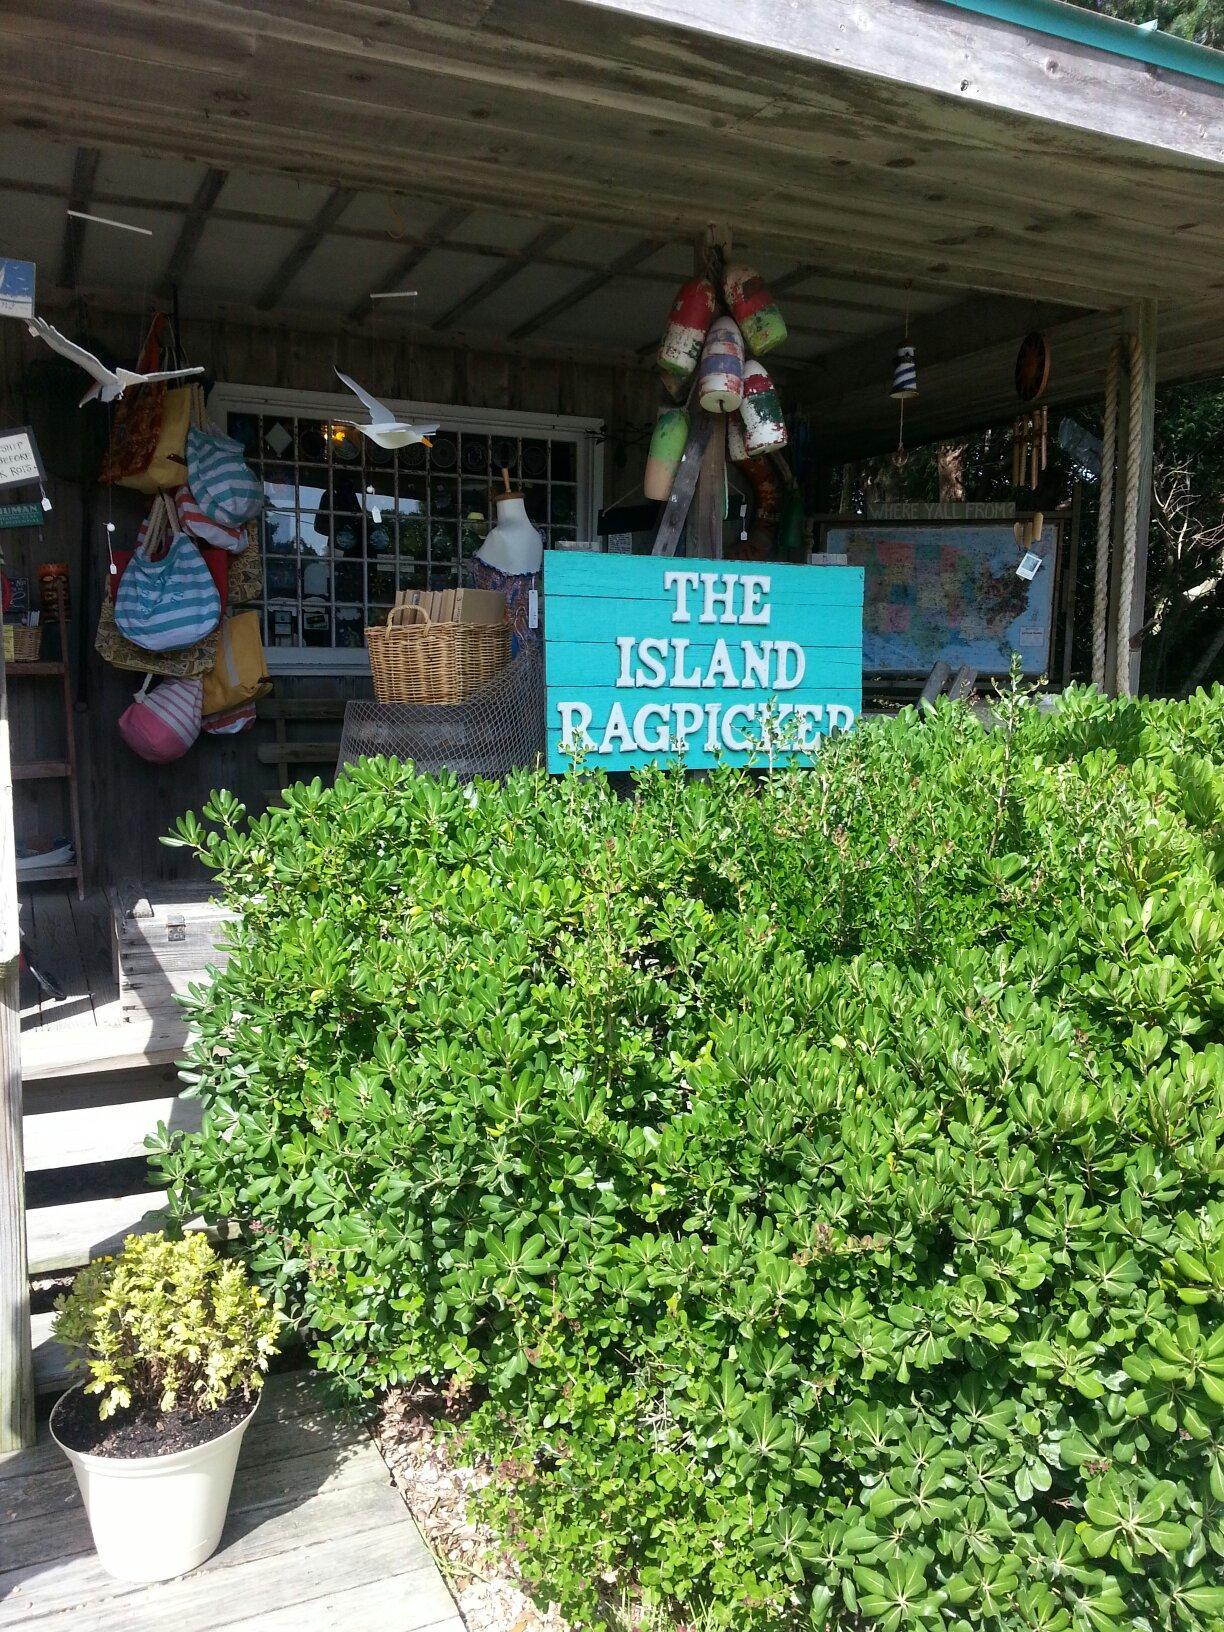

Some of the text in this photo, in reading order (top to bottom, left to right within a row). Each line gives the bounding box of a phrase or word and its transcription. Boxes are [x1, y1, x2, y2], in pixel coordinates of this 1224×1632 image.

[868, 502, 918, 520] WHERE
[965, 501, 1015, 519] FROM?
[664, 571, 771, 625] THE
[615, 636, 806, 690] ISLAND
